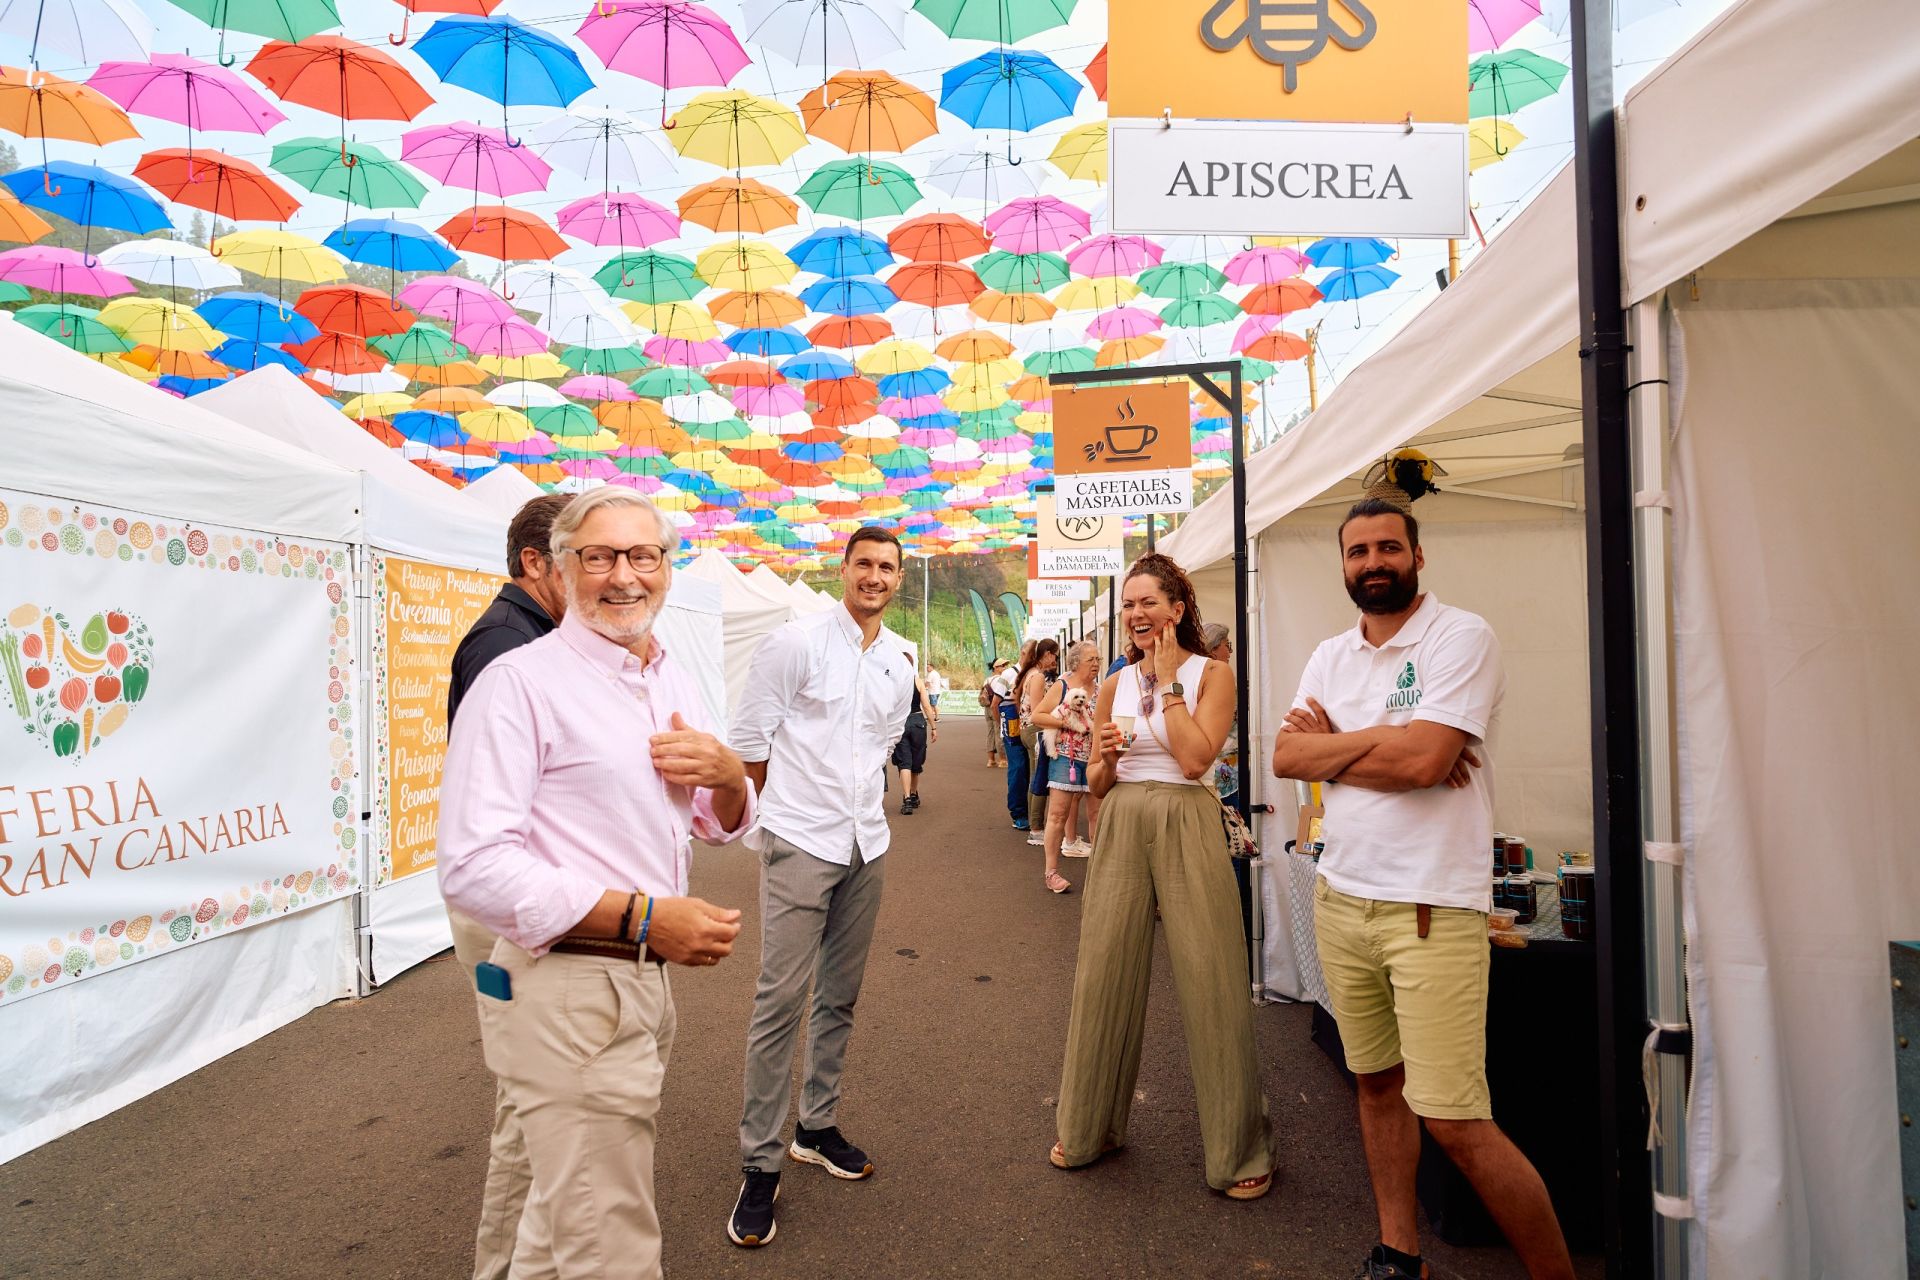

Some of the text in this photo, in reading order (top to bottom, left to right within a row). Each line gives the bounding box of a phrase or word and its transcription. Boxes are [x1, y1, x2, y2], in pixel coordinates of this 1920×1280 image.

[1165, 160, 1413, 200] APISCREA
[1066, 492, 1182, 510] MASPALOMAS
[1076, 478, 1171, 496] CAFETALES
[402, 564, 442, 599] Paisaje
[1043, 562, 1120, 571] LA DAMA DEL PAN
[446, 571, 490, 597] Productos
[392, 676, 433, 699] Calidad
[394, 746, 444, 784] Paisaje
[0, 776, 162, 844] FERIA
[115, 801, 292, 871] CANARIA
